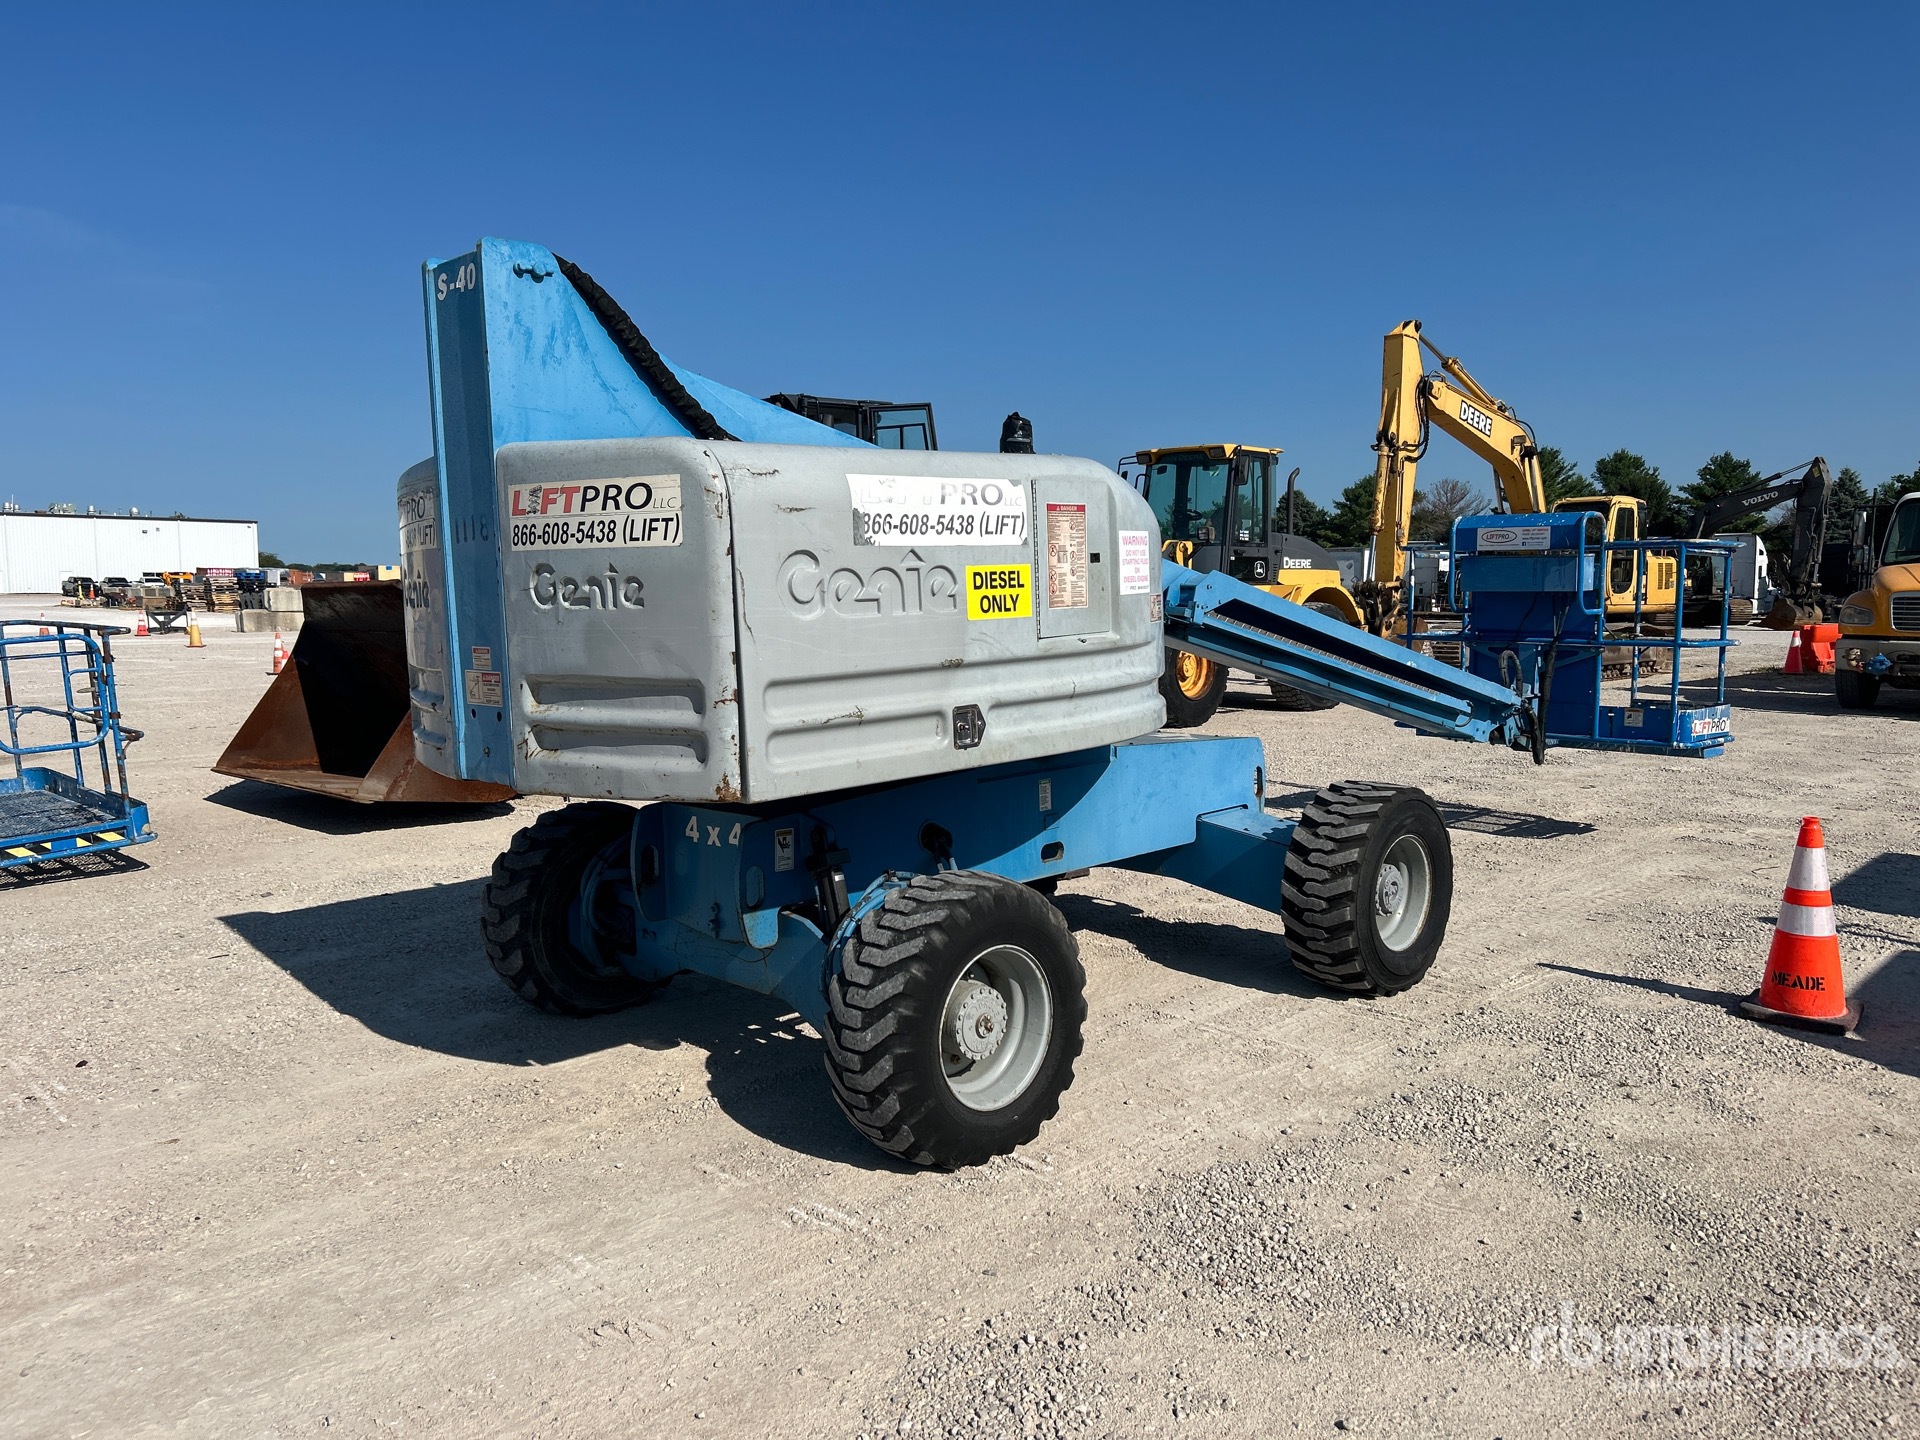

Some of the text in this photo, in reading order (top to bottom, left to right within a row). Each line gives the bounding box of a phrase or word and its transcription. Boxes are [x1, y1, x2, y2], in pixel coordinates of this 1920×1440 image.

[437, 262, 476, 301] S-40
[1459, 399, 1492, 438] DEERE
[652, 496, 677, 509] LLC
[1004, 495, 1022, 507] LLC
[1741, 491, 1779, 507] VOLVO
[512, 513, 681, 547] 866-608-5438 (LIFT)
[864, 510, 1025, 538] 866-608-5438 (LIFT)
[1122, 536, 1147, 546] WARNING
[1283, 556, 1312, 569] DEERE
[529, 561, 645, 610] Genie
[777, 548, 958, 621] Genie
[973, 570, 1025, 591] DIESEL
[980, 593, 1020, 614] ONLY
[685, 815, 741, 848] 4 x 4
[1771, 969, 1826, 992] MEADE
